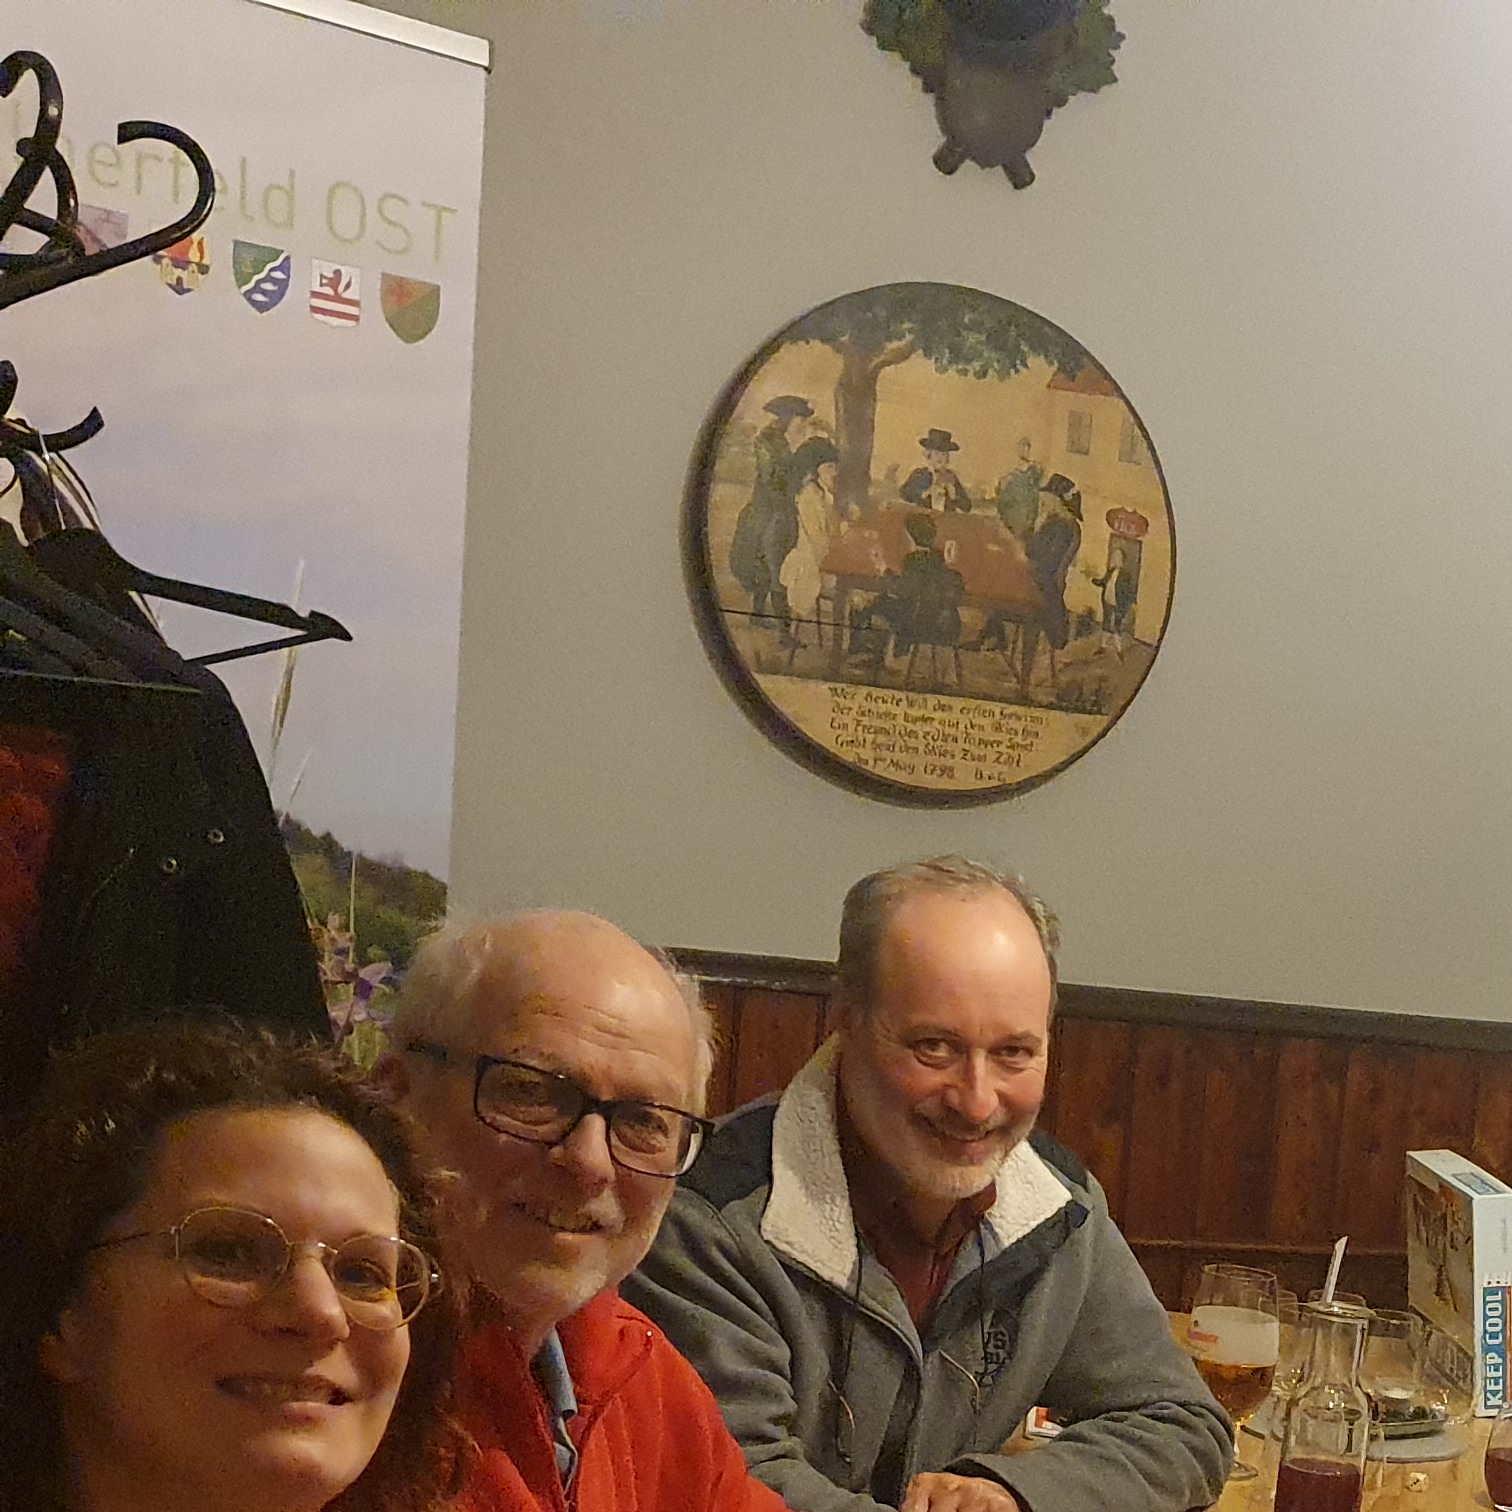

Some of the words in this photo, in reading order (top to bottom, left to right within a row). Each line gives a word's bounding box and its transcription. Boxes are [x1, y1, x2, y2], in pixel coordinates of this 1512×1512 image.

[326, 181, 458, 261] OST
[1485, 1290, 1503, 1346] COOL
[1486, 1351, 1504, 1407] KEEP
